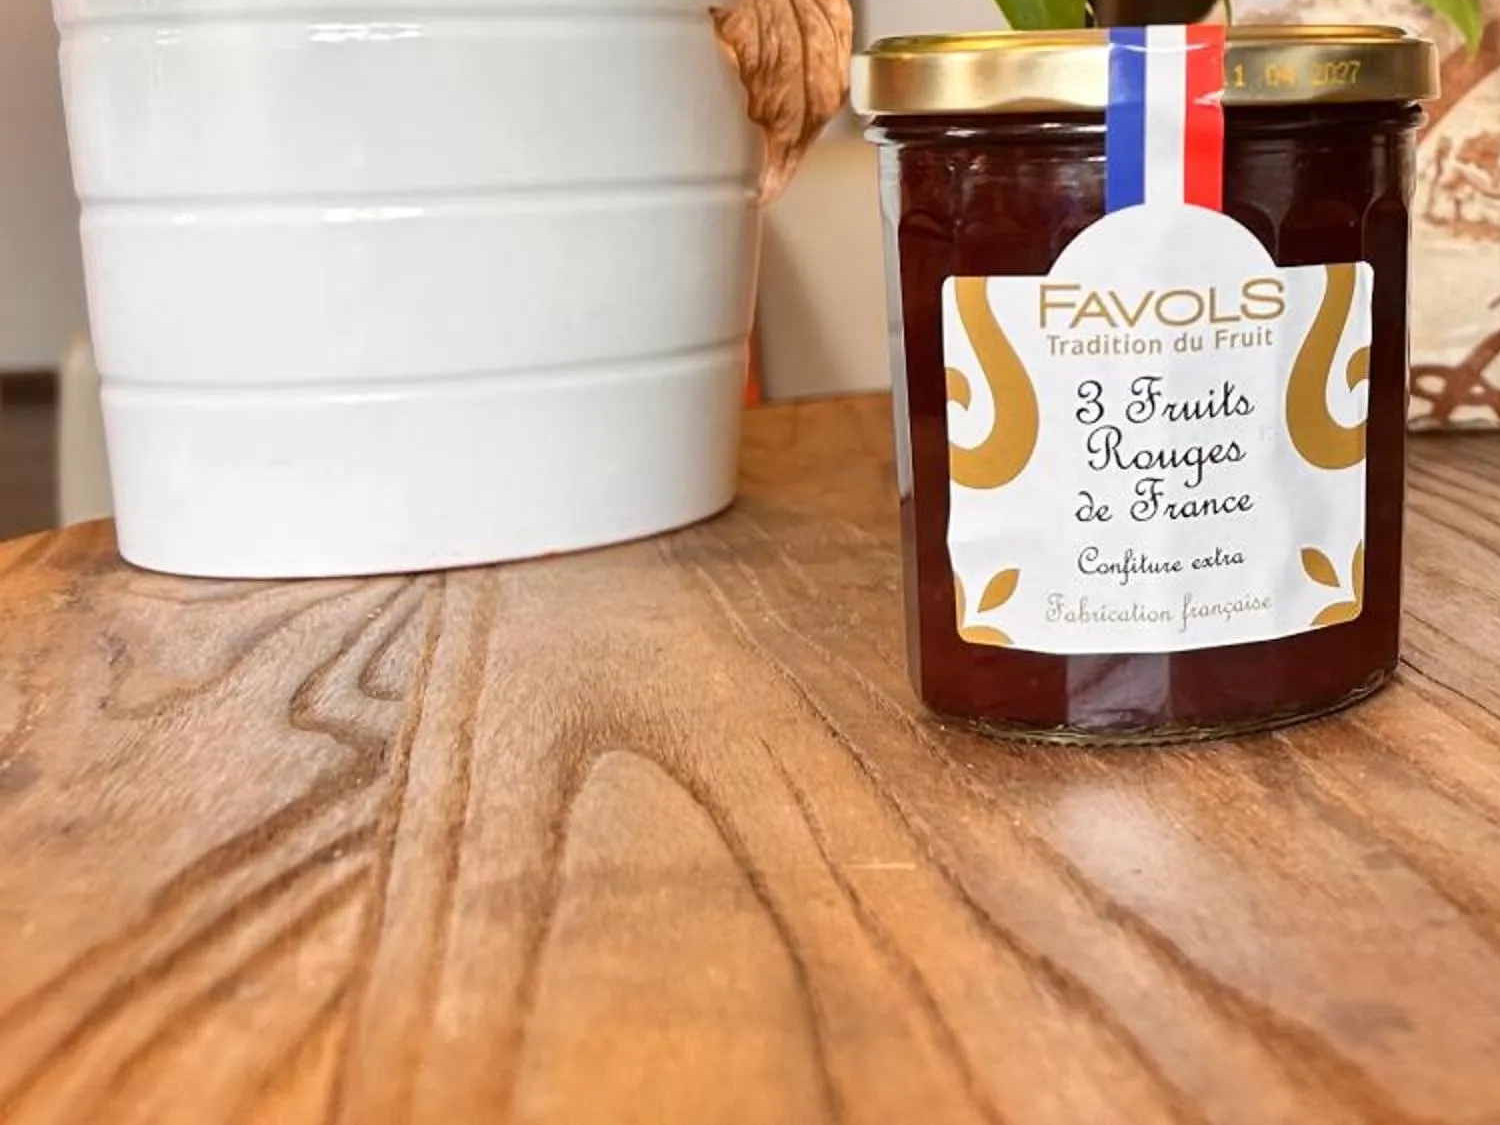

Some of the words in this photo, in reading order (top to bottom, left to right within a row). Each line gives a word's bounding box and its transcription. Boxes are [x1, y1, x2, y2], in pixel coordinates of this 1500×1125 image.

[1310, 59, 1361, 86] 2027
[1038, 277, 1286, 329] FAVOLS
[1046, 333, 1162, 356] Tradition
[1173, 331, 1204, 354] du
[1214, 326, 1274, 350] Fruit
[1075, 379, 1105, 425] 3
[1125, 375, 1255, 424] Fruits
[1086, 424, 1247, 489] Rouges
[1074, 490, 1114, 523] de
[1129, 476, 1255, 523] France
[1077, 545, 1184, 586] Confiture
[1190, 546, 1245, 570] extra
[1045, 592, 1174, 624] Fabrication
[1178, 591, 1274, 634] française
